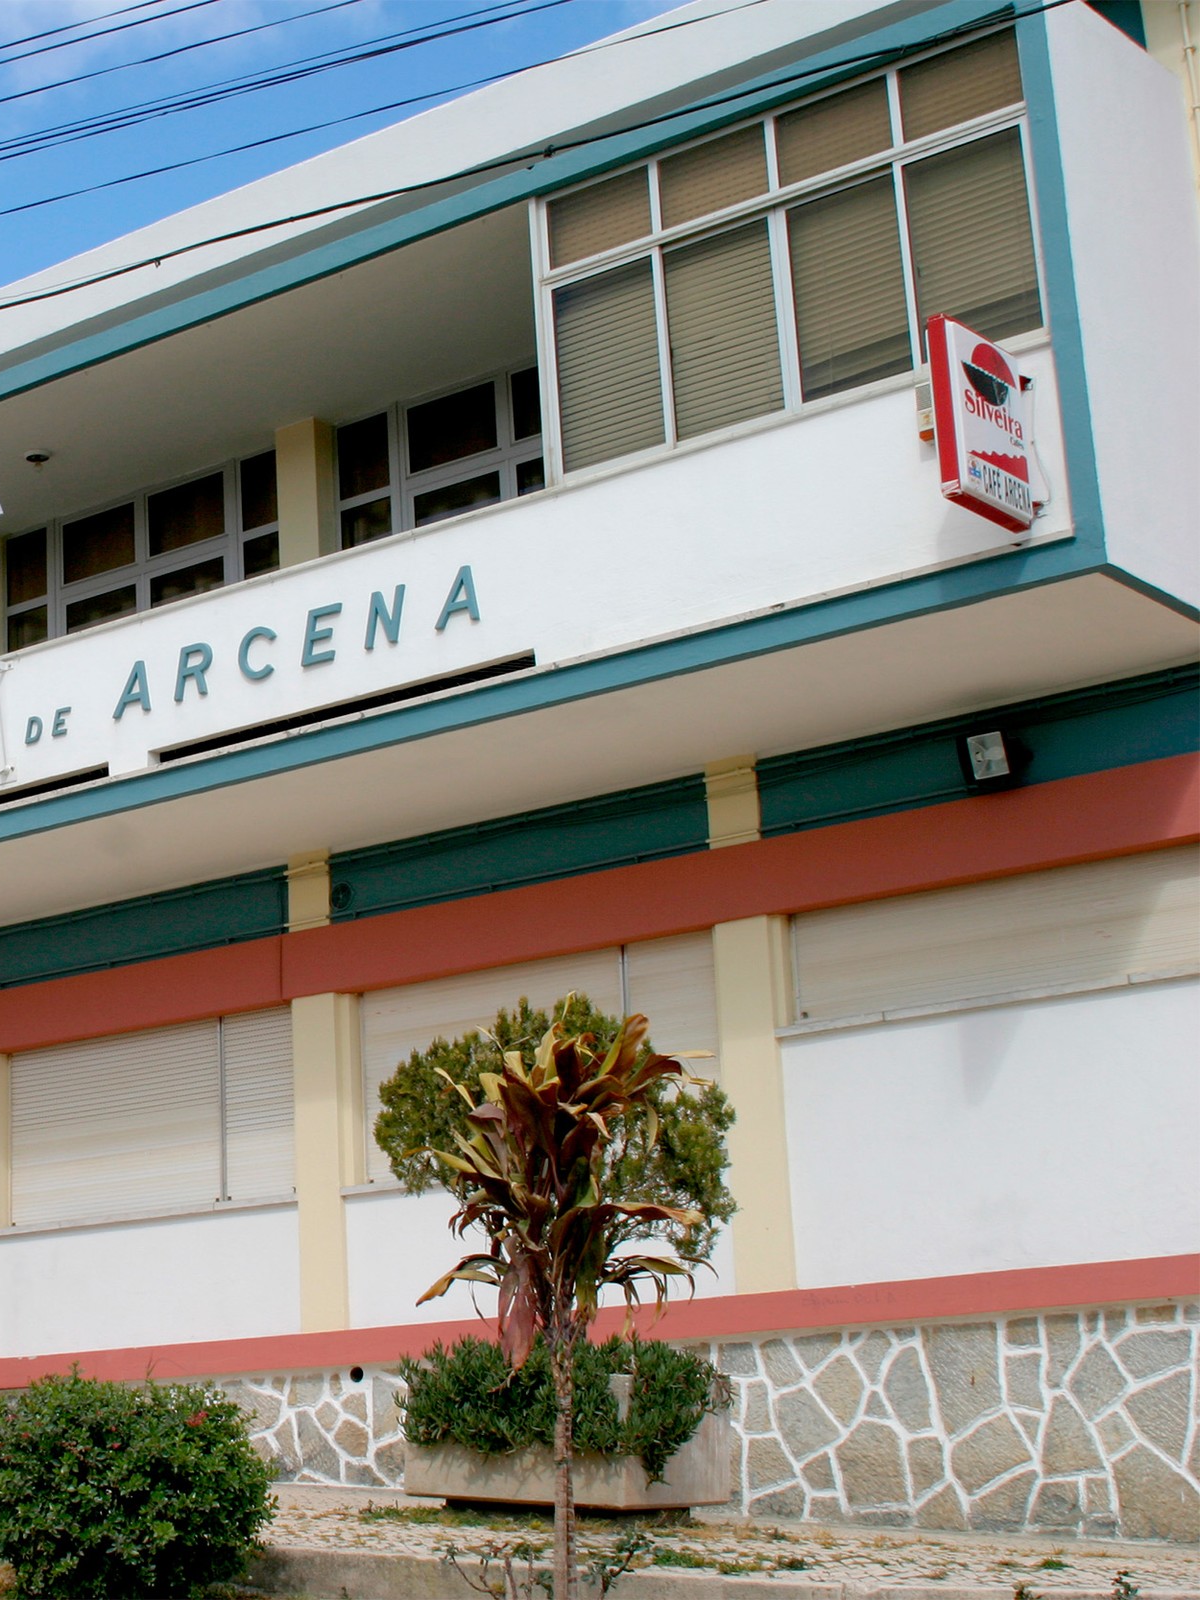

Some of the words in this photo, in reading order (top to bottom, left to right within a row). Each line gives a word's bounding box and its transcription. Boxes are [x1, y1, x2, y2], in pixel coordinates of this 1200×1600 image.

[965, 389, 1023, 440] Silveira
[983, 464, 1002, 500] CAFÉ
[1004, 475, 1031, 516] ARCENA
[26, 706, 71, 744] DE
[114, 566, 481, 720] ARCENA
